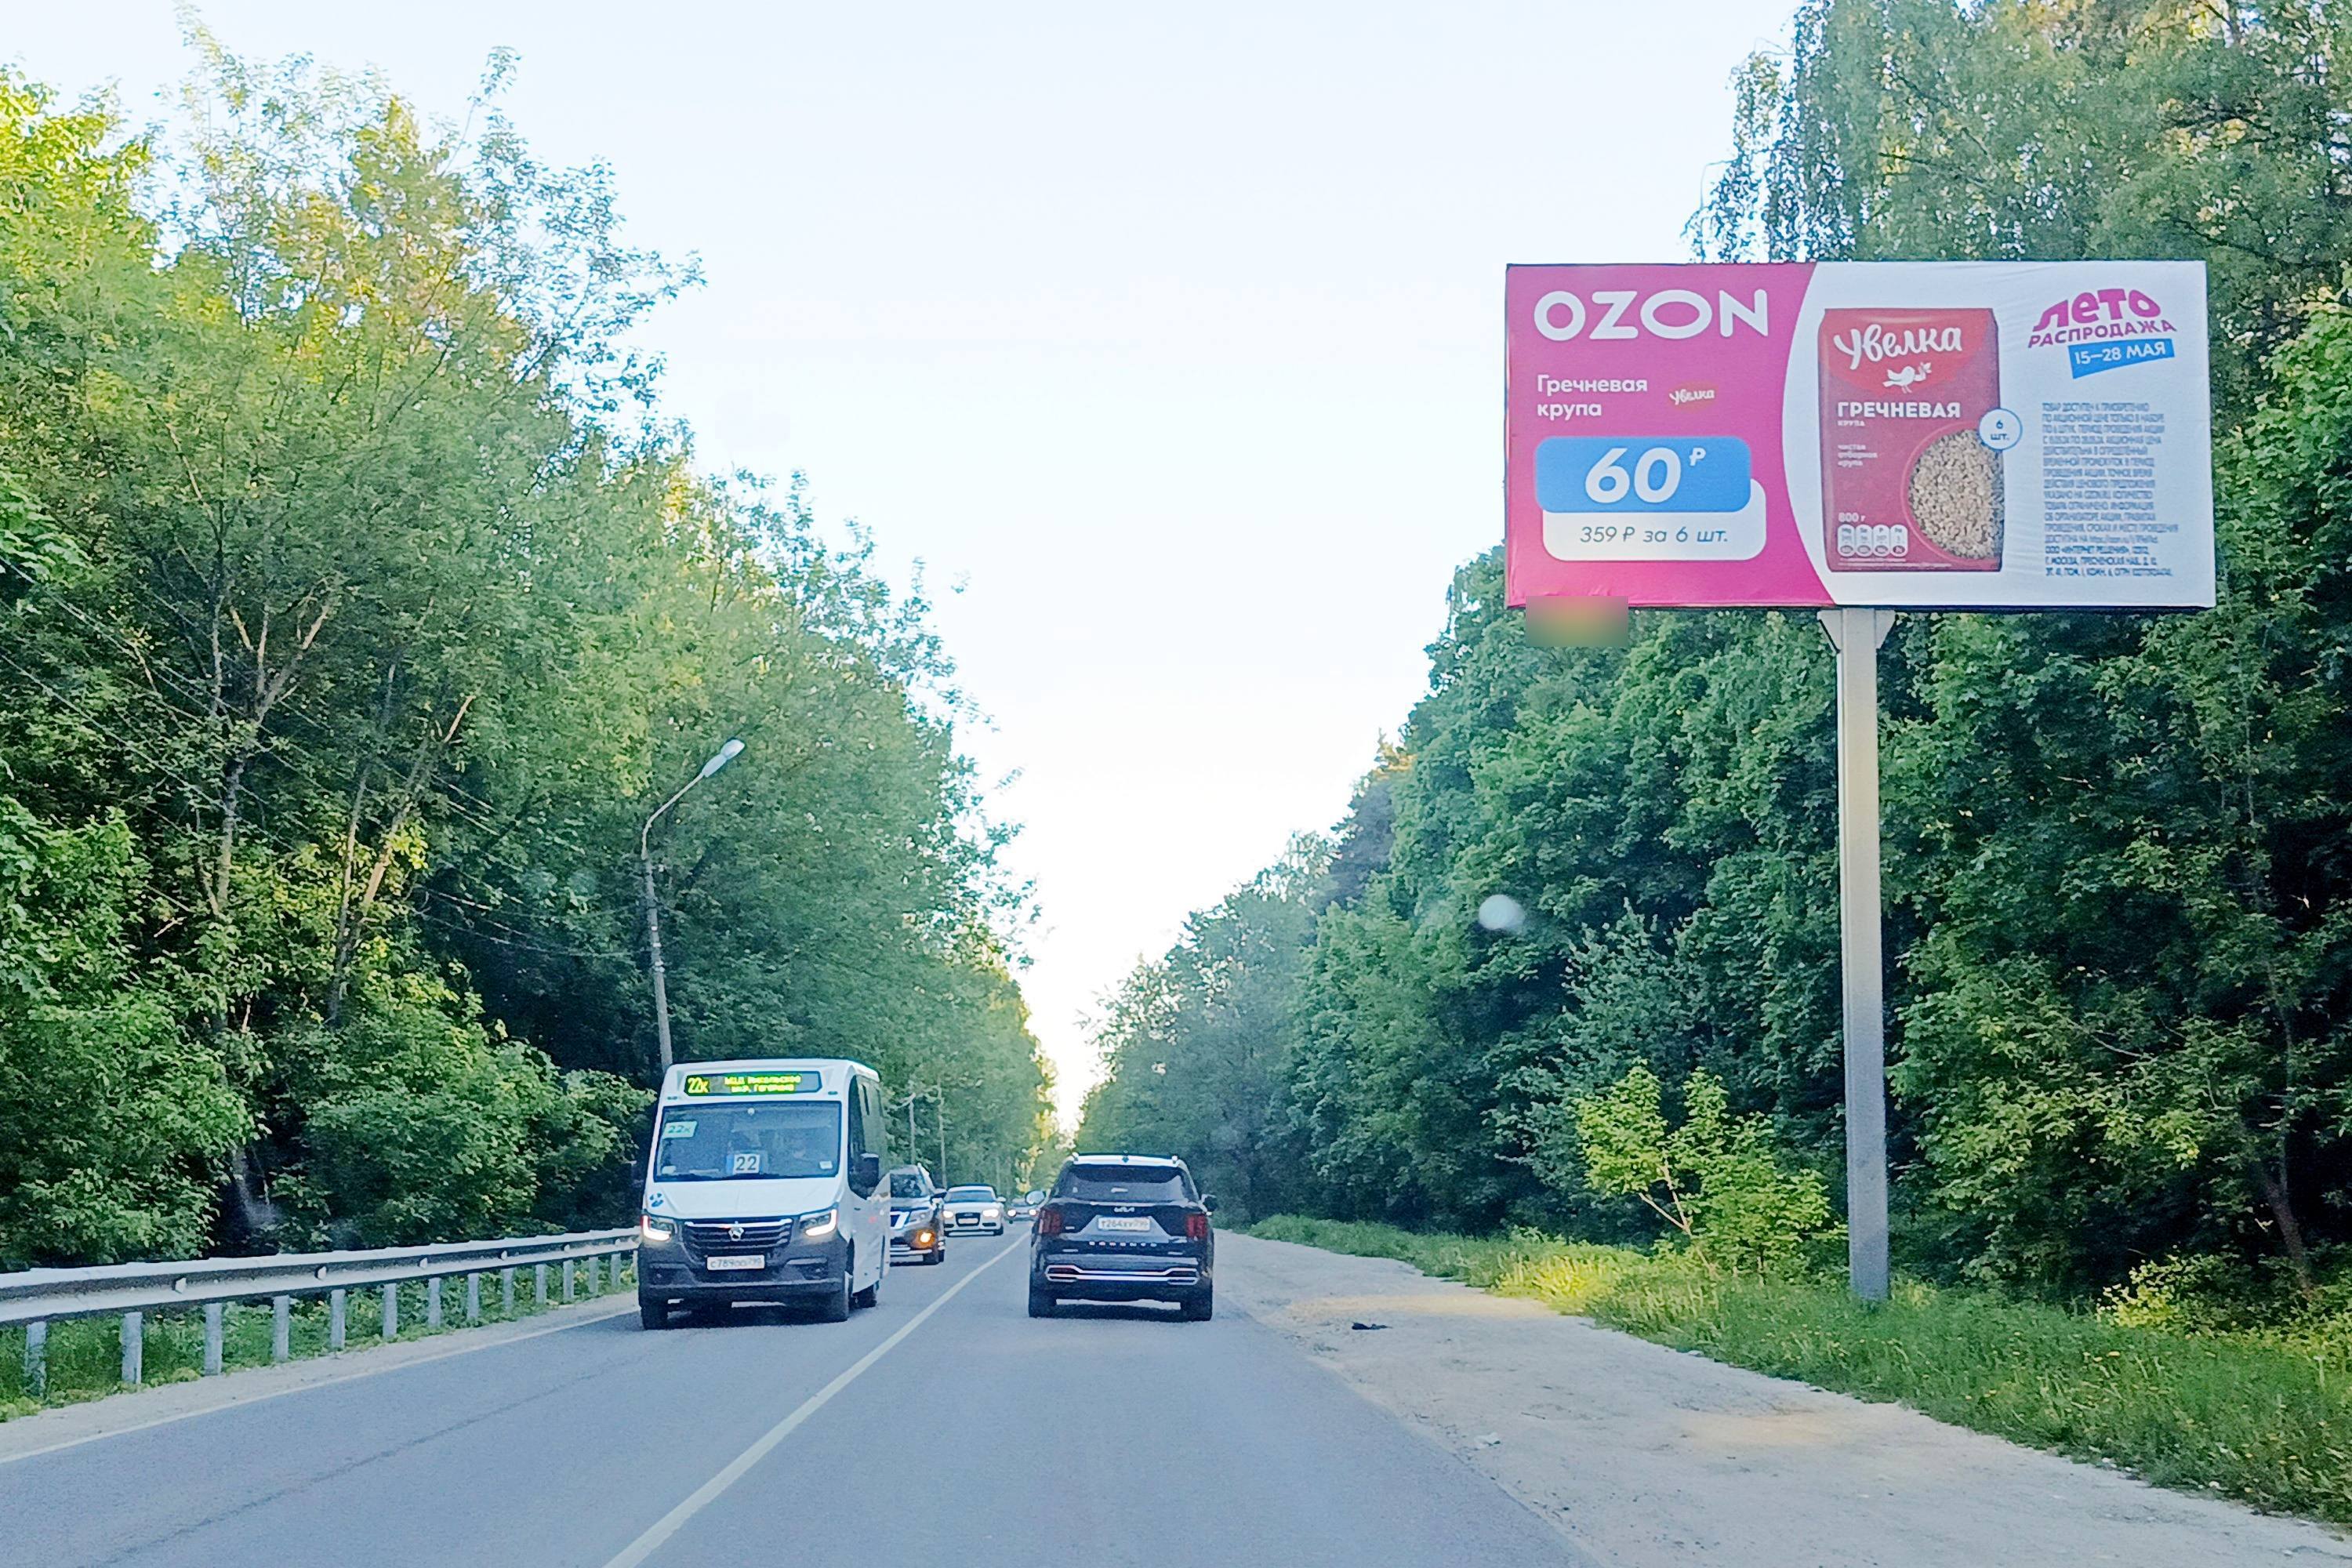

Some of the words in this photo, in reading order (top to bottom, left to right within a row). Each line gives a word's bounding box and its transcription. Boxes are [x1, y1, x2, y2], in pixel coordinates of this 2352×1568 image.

[1534, 289, 1769, 341] OZON
[2027, 319, 2178, 348] РАСПРОДАЖА
[2126, 341, 2166, 359] МАЯ
[1537, 374, 1648, 397] Гречневая
[1537, 403, 1602, 420] крупа
[1837, 401, 1961, 418] ГРЕЧНЕВАЯ
[1995, 419, 2004, 430] 6
[1584, 447, 1682, 504] 60
[1580, 526, 1617, 543] 359
[1643, 530, 1667, 543] за
[1676, 526, 1688, 543] 6
[735, 1156, 757, 1171] 22
